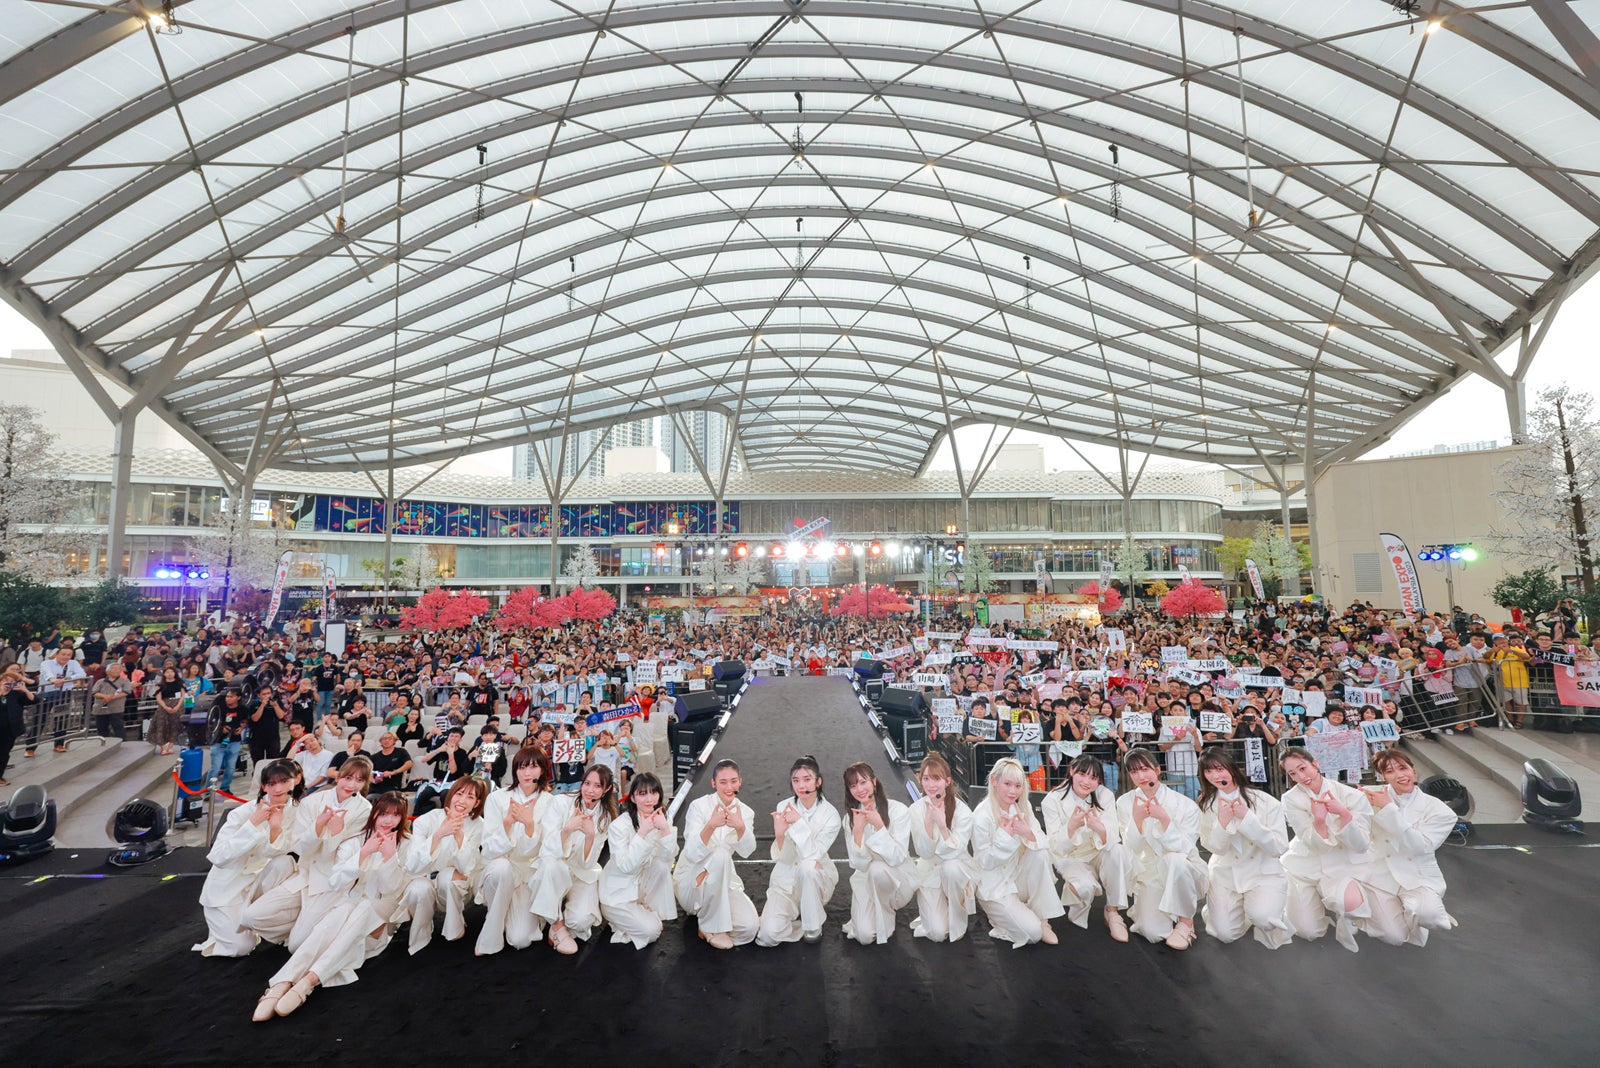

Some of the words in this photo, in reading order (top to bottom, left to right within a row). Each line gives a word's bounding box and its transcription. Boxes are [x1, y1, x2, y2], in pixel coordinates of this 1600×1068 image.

[1402, 586, 1416, 620] JAPAN
[603, 706, 639, 721] 森田ひかる
[1202, 713, 1230, 731] 里奈
